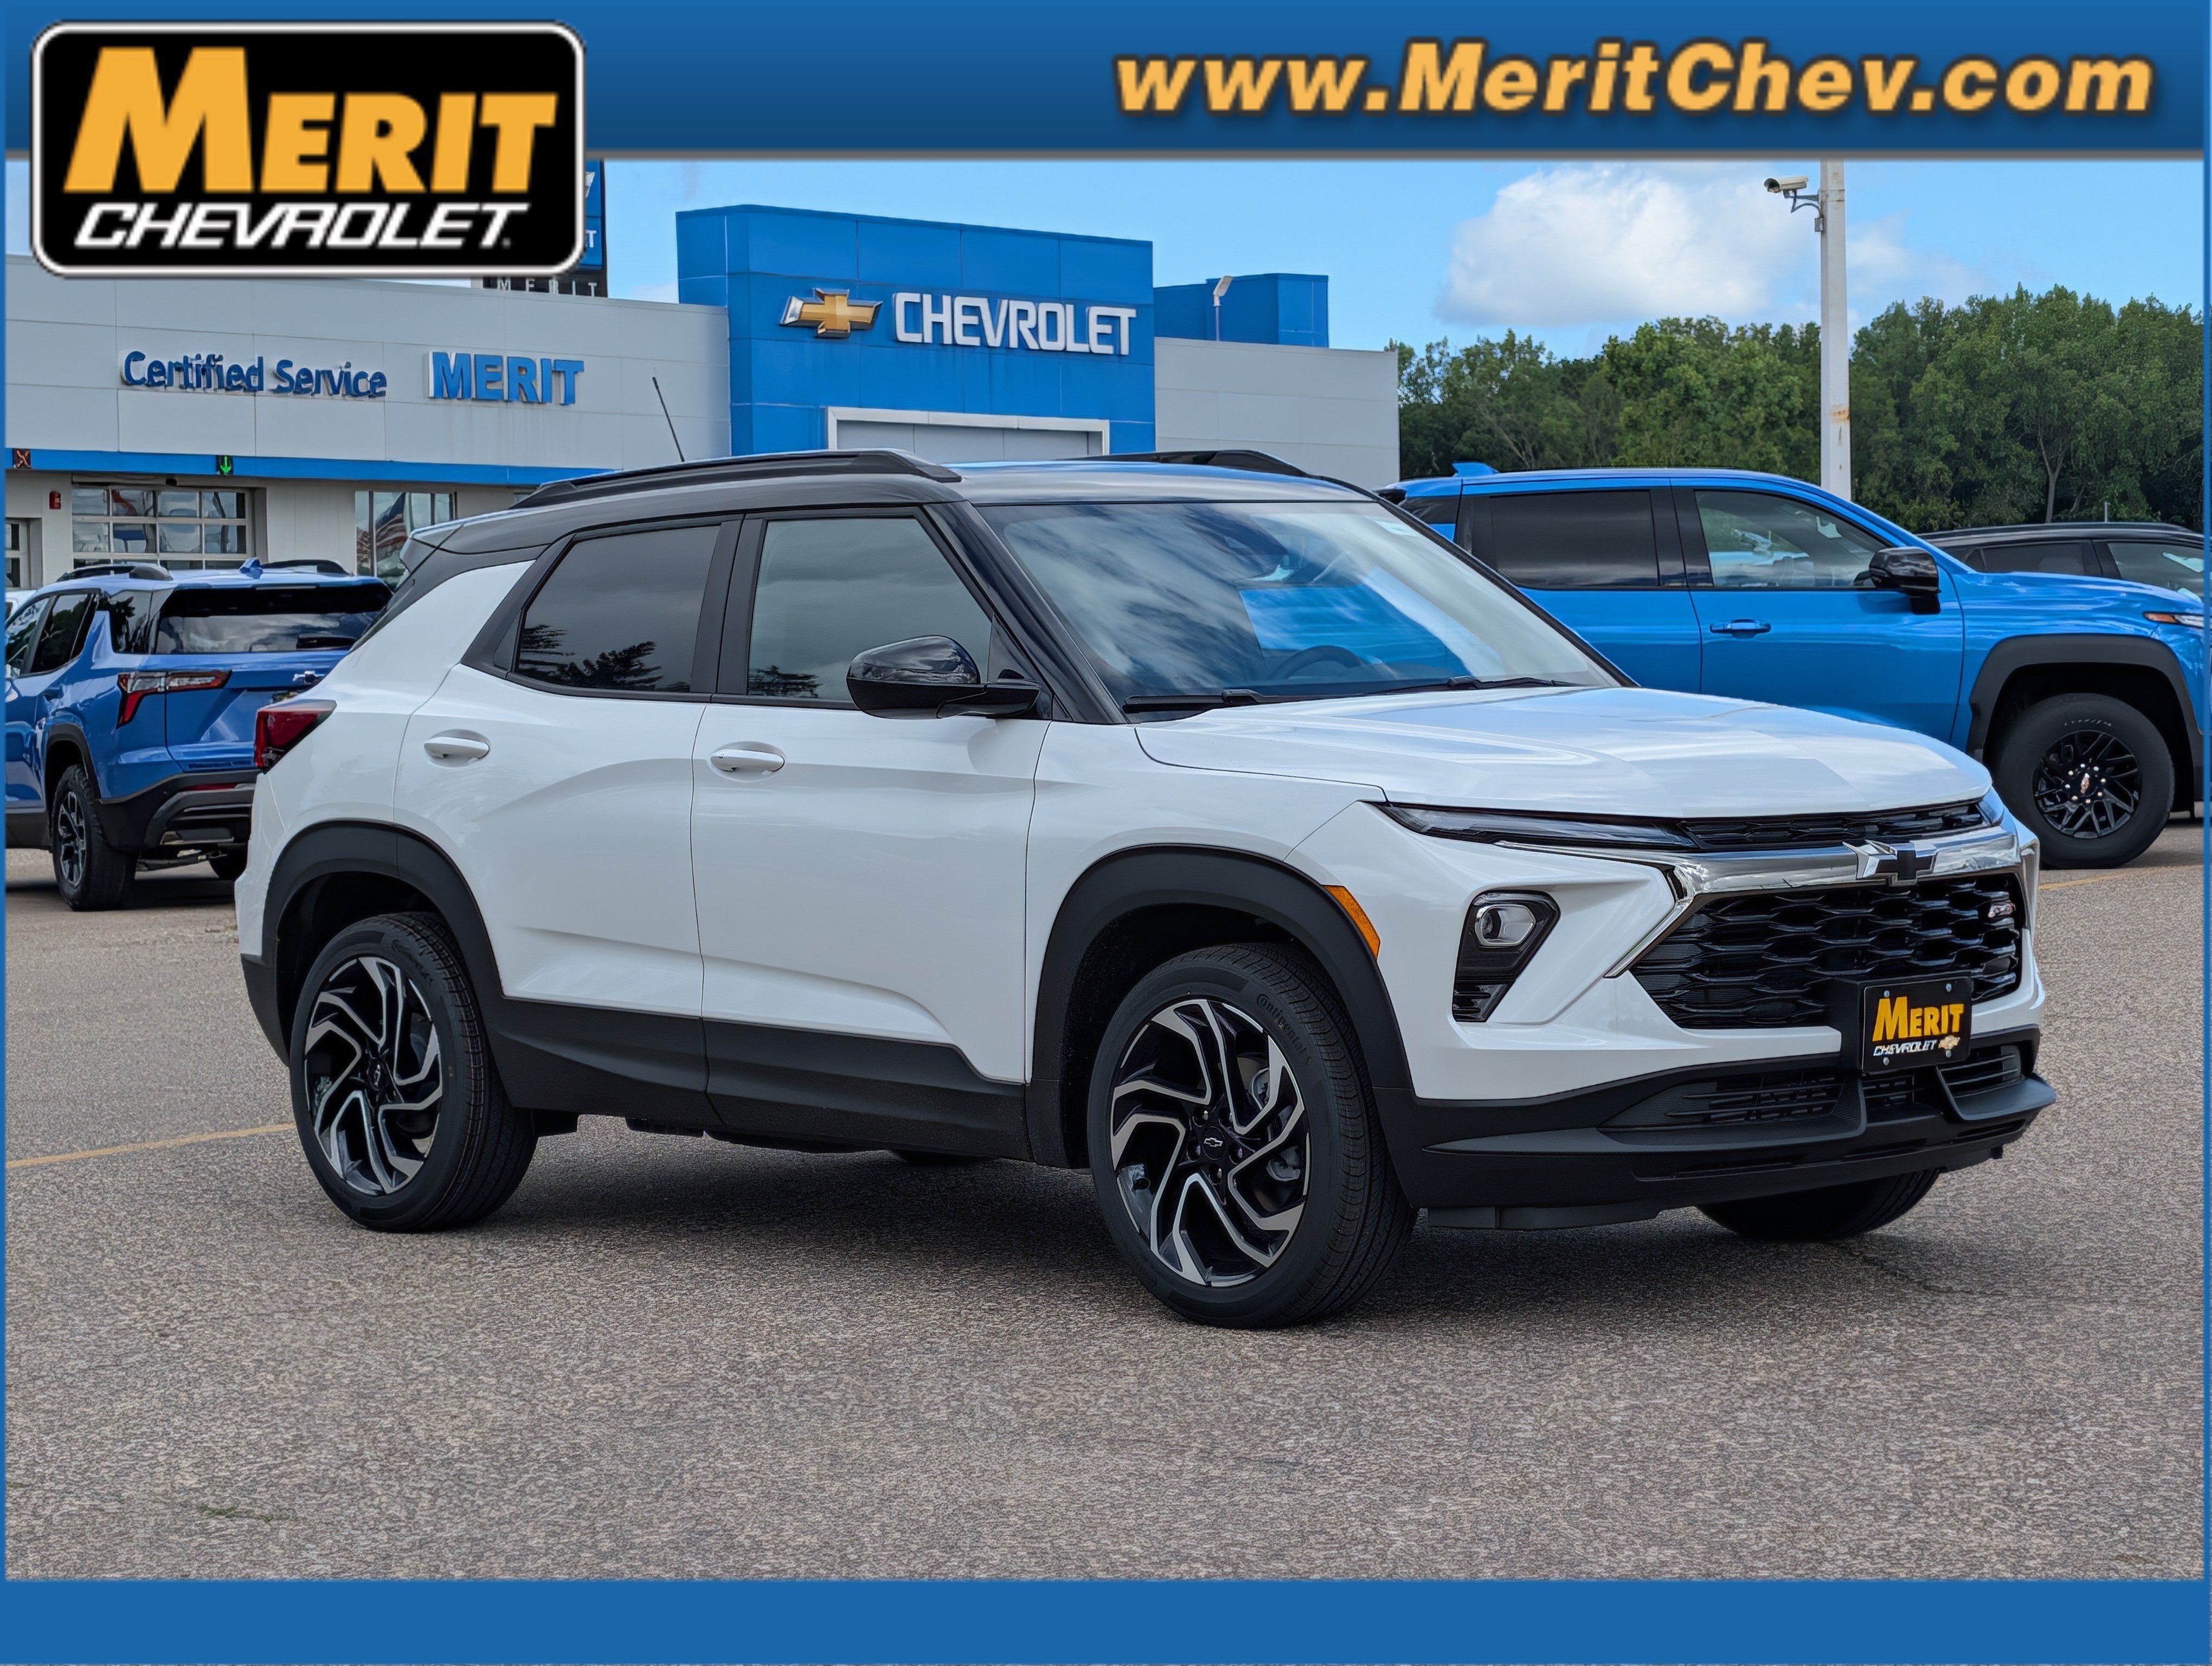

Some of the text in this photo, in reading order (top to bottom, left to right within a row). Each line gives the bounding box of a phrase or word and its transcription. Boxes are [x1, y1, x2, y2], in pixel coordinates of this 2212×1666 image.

[893, 292, 1137, 355] CHEVROLET
[123, 350, 387, 398] Certified Service
[429, 351, 584, 405] MERIT
[1873, 1040, 1938, 1056] CHEVROLET
